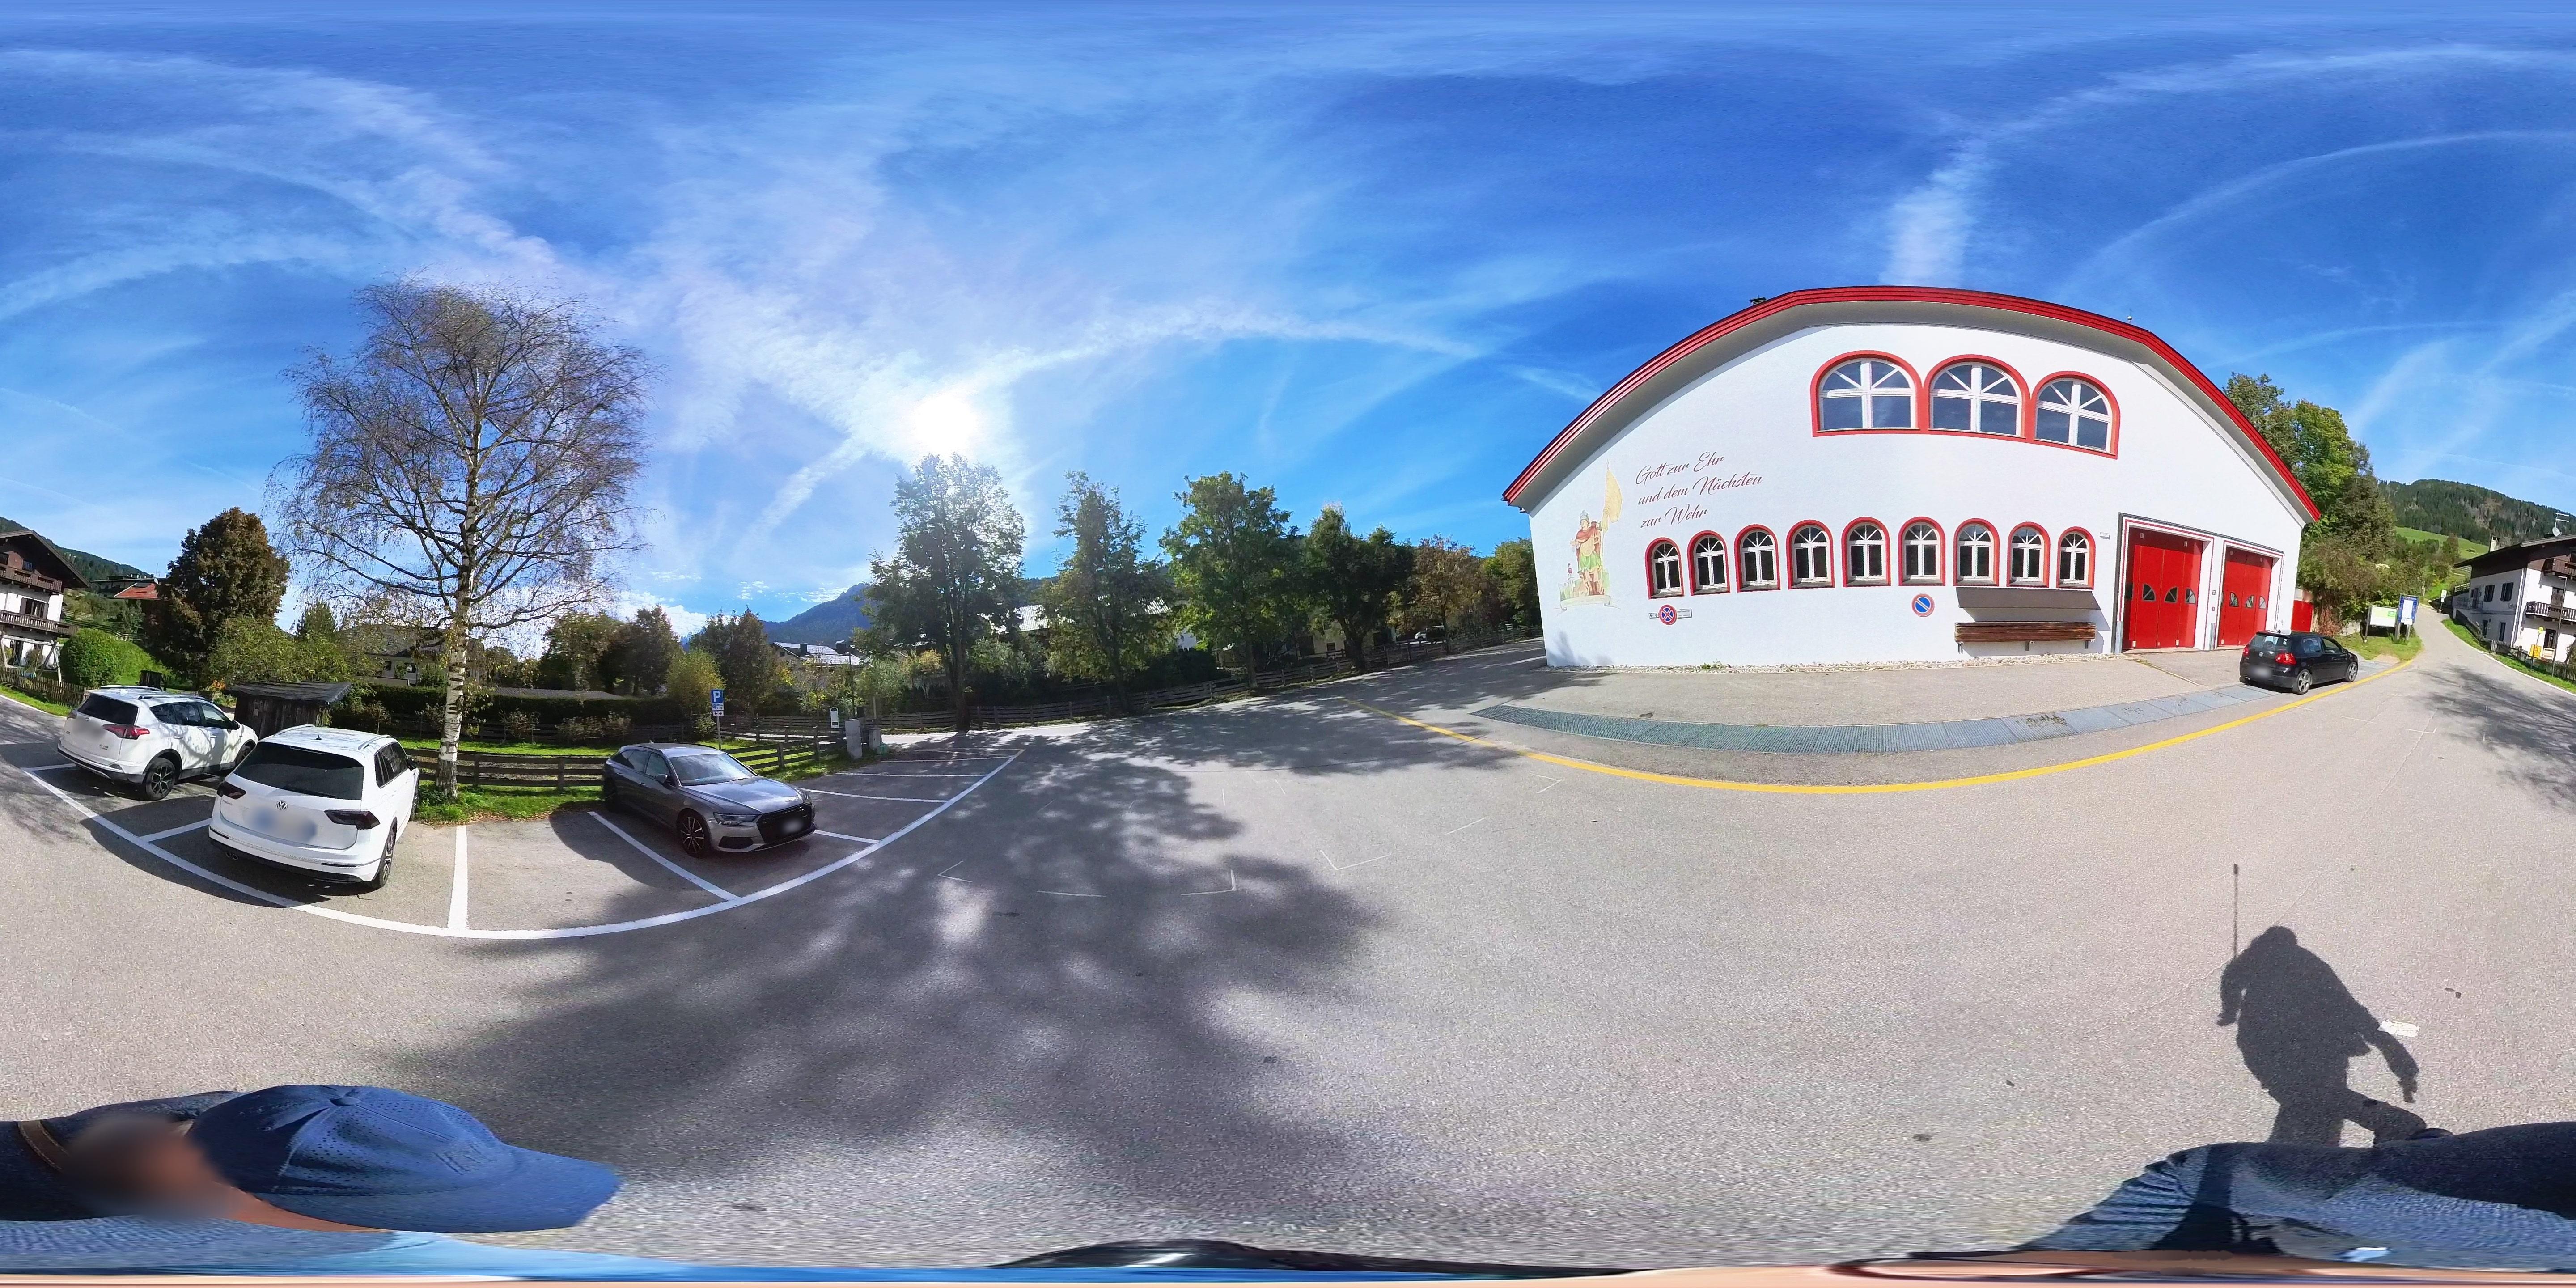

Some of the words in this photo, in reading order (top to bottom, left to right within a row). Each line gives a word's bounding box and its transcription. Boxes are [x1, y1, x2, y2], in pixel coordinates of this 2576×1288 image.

[1635, 462, 1670, 486] Gott
[1667, 463, 1690, 475] zur
[1693, 451, 1725, 472] Ehr
[1638, 487, 1664, 505] und
[1664, 484, 1689, 500] dem
[1692, 471, 1763, 495] Nächsten
[1640, 517, 1662, 528] zur
[1664, 504, 1708, 525] Wehr
[713, 691, 721, 702] P
